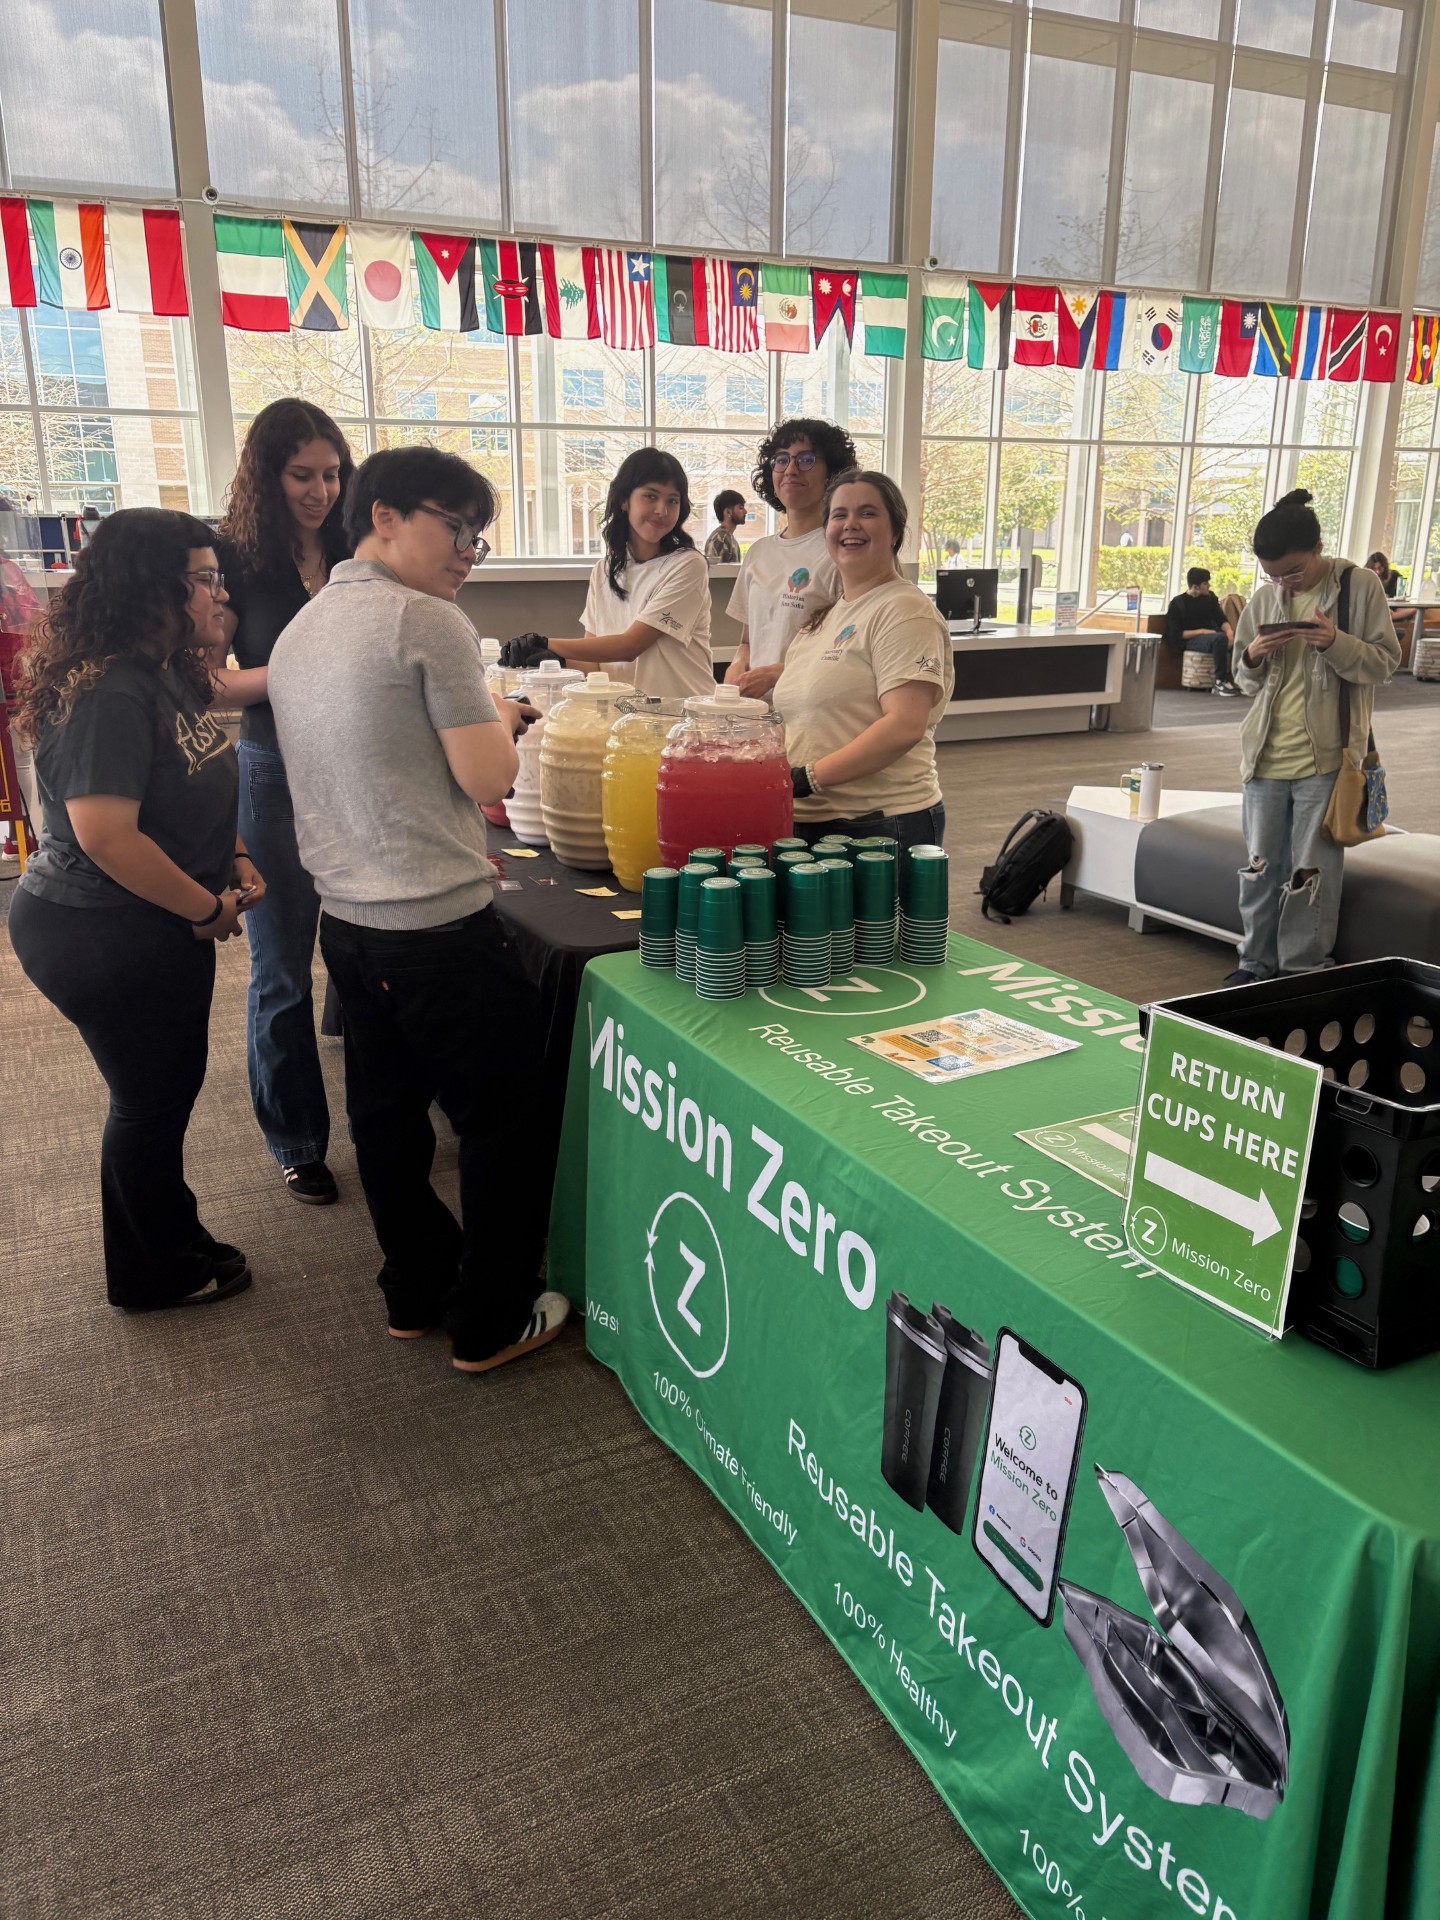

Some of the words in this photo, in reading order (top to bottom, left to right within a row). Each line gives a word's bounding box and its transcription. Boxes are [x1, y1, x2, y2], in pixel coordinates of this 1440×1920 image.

[749, 1023, 875, 1096] Reusable
[871, 1094, 1015, 1178] Takeout
[1170, 1051, 1286, 1120] RETURN
[588, 1001, 732, 1193] Mission
[747, 1124, 877, 1311] Zero
[1147, 1093, 1216, 1142] CUPS
[1223, 1123, 1299, 1179] HERE
[1171, 1237, 1230, 1280] Mission
[1233, 1268, 1271, 1302] Zero
[653, 1371, 692, 1418] 100%
[990, 1450, 1029, 1496] Mission
[1032, 1487, 1057, 1522] Zero
[995, 1433, 1043, 1487] Welcome
[1046, 1481, 1058, 1502] to
[788, 1418, 914, 1588] Reusable
[924, 1566, 1058, 1770] Takeout
[833, 1582, 887, 1650] 100%
[890, 1639, 957, 1748] Healthy
[1019, 1829, 1086, 1920] 100%
